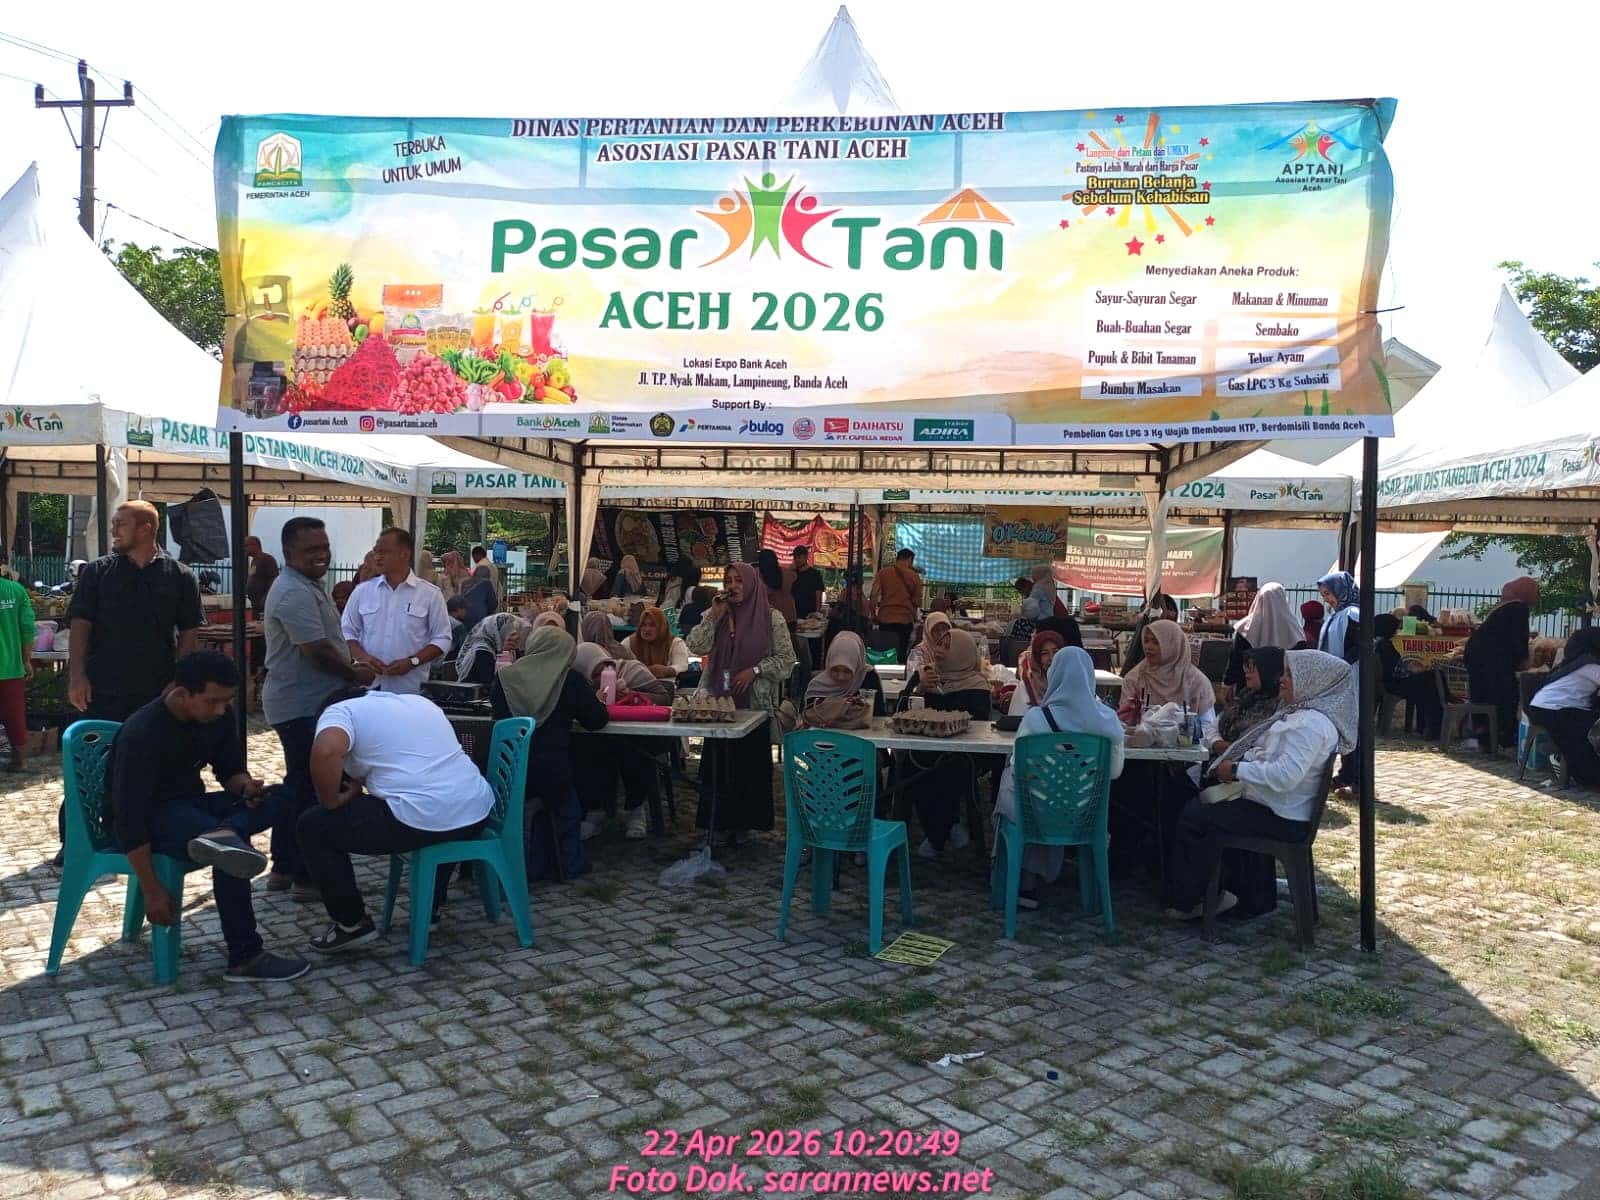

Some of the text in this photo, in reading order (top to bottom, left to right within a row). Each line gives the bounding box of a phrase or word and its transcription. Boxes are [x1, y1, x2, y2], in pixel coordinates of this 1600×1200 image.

[511, 112, 1005, 137] DINAS PERTANIAN DAN PERKEBUNAN ACEH
[393, 135, 446, 159] TERBUKA
[596, 139, 909, 163] ASOSIASI PASAR TANI ACEH
[382, 157, 462, 184] UNTUK UMUM
[1180, 160, 1199, 171] Pasar
[1282, 163, 1344, 176] APTANI
[1087, 175, 1197, 191] Buruan Belanja
[1302, 184, 1322, 192] Aceh
[1333, 176, 1347, 185] Tani
[246, 190, 310, 200] PEMERINTAH ACEH
[1072, 189, 1210, 205] Sebelum Kehabisan
[490, 217, 1004, 273] Pasar Tani
[1145, 265, 1299, 278] Menyediakan Aneka Produk:
[1095, 290, 1197, 307] Sayur-Sayuran Segar
[1232, 292, 1329, 308] Makanan & Minuman
[599, 291, 885, 332] ACEH 2026
[1096, 319, 1192, 336] Buah-Buahan Segar
[1255, 323, 1299, 338] Sembako
[683, 357, 788, 371] Lokasi Expo Bank Aceh
[1088, 350, 1196, 367] Pupuk & Bibit Tanaman
[1248, 351, 1305, 367] Telur Ayam
[638, 372, 849, 392] Jl. T.P. Nyak Makam, Lampineung, Banda Aceh
[1100, 381, 1181, 396] Bumbu Masakan
[1228, 372, 1330, 392] Gas LPG 3 Kg Subsidi
[712, 400, 747, 413] Support
[749, 400, 767, 412] By
[33, 416, 63, 432] Tani
[332, 416, 348, 426] Aceh
[376, 417, 438, 429] @pasartani.aceh
[517, 416, 581, 427] Bank Aceh
[697, 424, 732, 432] PERTAMINA
[749, 419, 784, 436] bulog
[852, 421, 904, 431] DAIHATSU
[919, 427, 969, 436] ADIRA
[1063, 420, 1366, 439] Pembelian Gas LPG 3 Kg Wajib Membawa KTP, Berdomisili Banda Aceh
[161, 417, 209, 447] PASAR
[245, 433, 311, 463] DISTANBUN
[313, 446, 339, 472] ACEH
[341, 455, 365, 476] 2024
[465, 474, 517, 489] PASAR
[1402, 475, 1423, 494] TANI
[1423, 464, 1480, 490] DISTANBUN
[1482, 459, 1511, 483] ACEH
[1514, 453, 1547, 478] 2024
[1180, 482, 1226, 499] 2024
[1250, 489, 1324, 500] Pasar Tani
